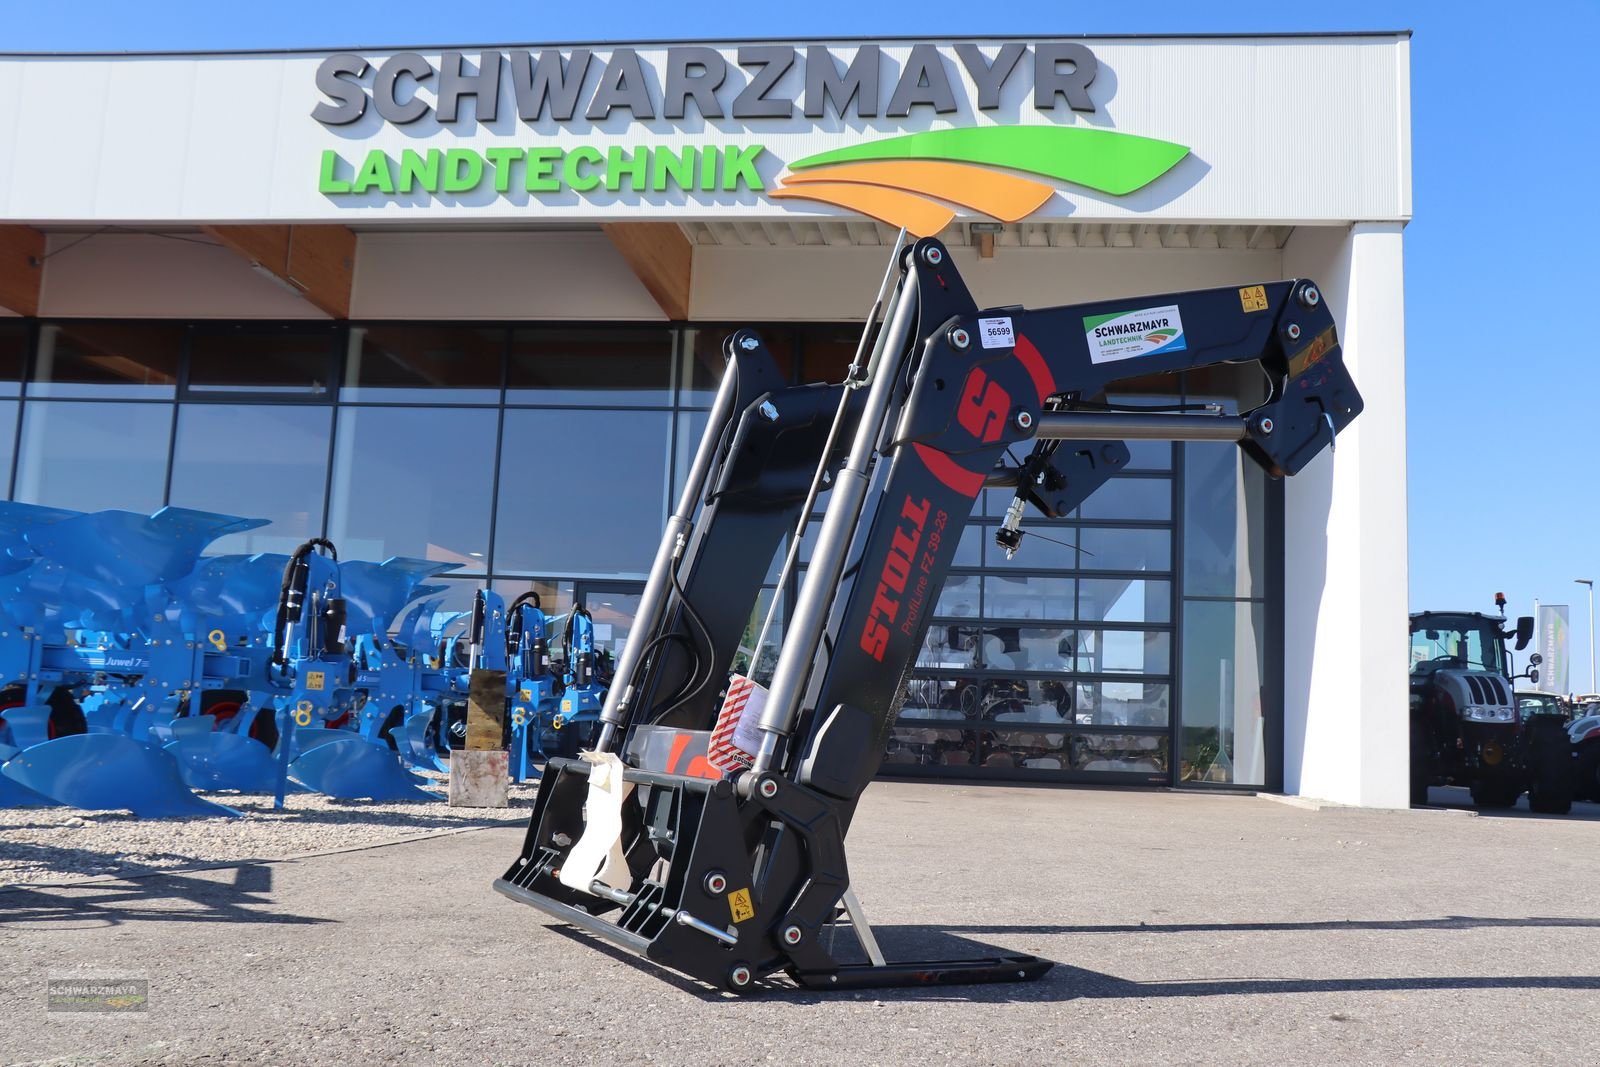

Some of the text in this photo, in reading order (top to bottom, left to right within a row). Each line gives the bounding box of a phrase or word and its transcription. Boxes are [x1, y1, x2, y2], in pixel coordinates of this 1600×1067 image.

[310, 42, 1099, 126] SCHWARZMAYR
[318, 144, 766, 195] LANDTECHNIK
[987, 327, 1011, 336] 56599
[1094, 318, 1169, 338] SCHWARZMAYR
[1098, 334, 1143, 347] LANDTECHNIK
[859, 493, 931, 663] STOLL
[901, 509, 948, 636] ProfiLine FZ 39-23
[105, 657, 142, 667] Juwel 7
